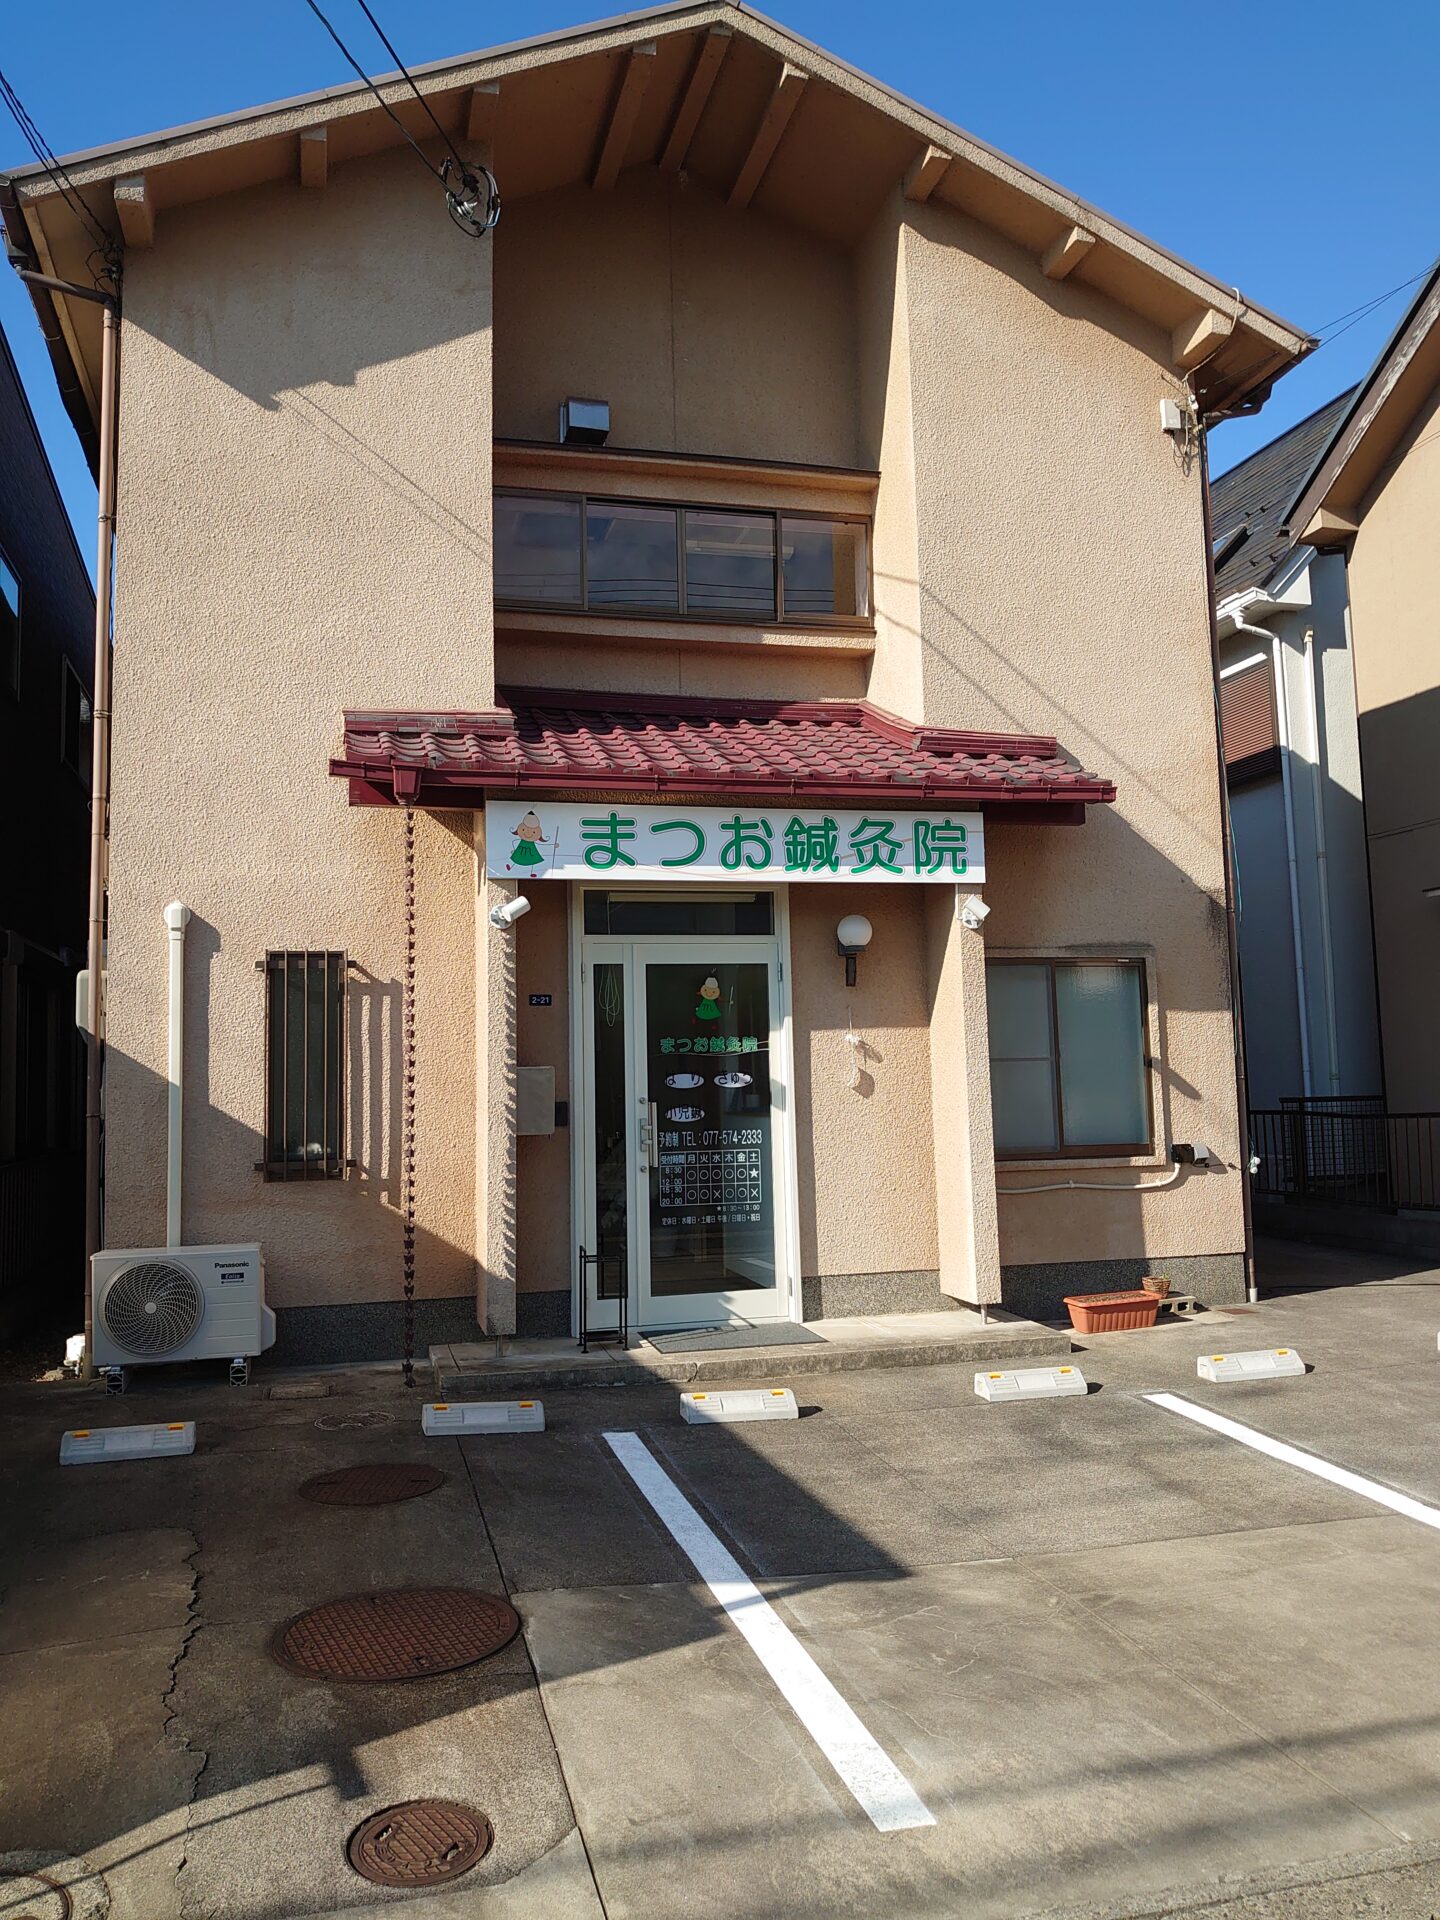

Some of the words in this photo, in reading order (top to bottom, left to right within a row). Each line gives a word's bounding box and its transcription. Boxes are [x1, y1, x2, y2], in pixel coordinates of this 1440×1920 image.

[579, 809, 969, 875] まつお鍼灸院
[531, 996, 550, 1004] 2-21
[660, 1036, 758, 1053] まつお鍼灸院
[659, 1131, 679, 1148] 予約制
[660, 1154, 686, 1165] 受付時間
[686, 1154, 696, 1164] 月
[700, 1153, 709, 1163] 火
[712, 1153, 721, 1163] 水
[724, 1153, 734, 1162] 木
[736, 1152, 746, 1162] 金
[749, 1152, 759, 1162] 土
[665, 1166, 683, 1174] 8:30
[662, 1186, 683, 1194] 15:30
[214, 1261, 250, 1269] Panasonic
